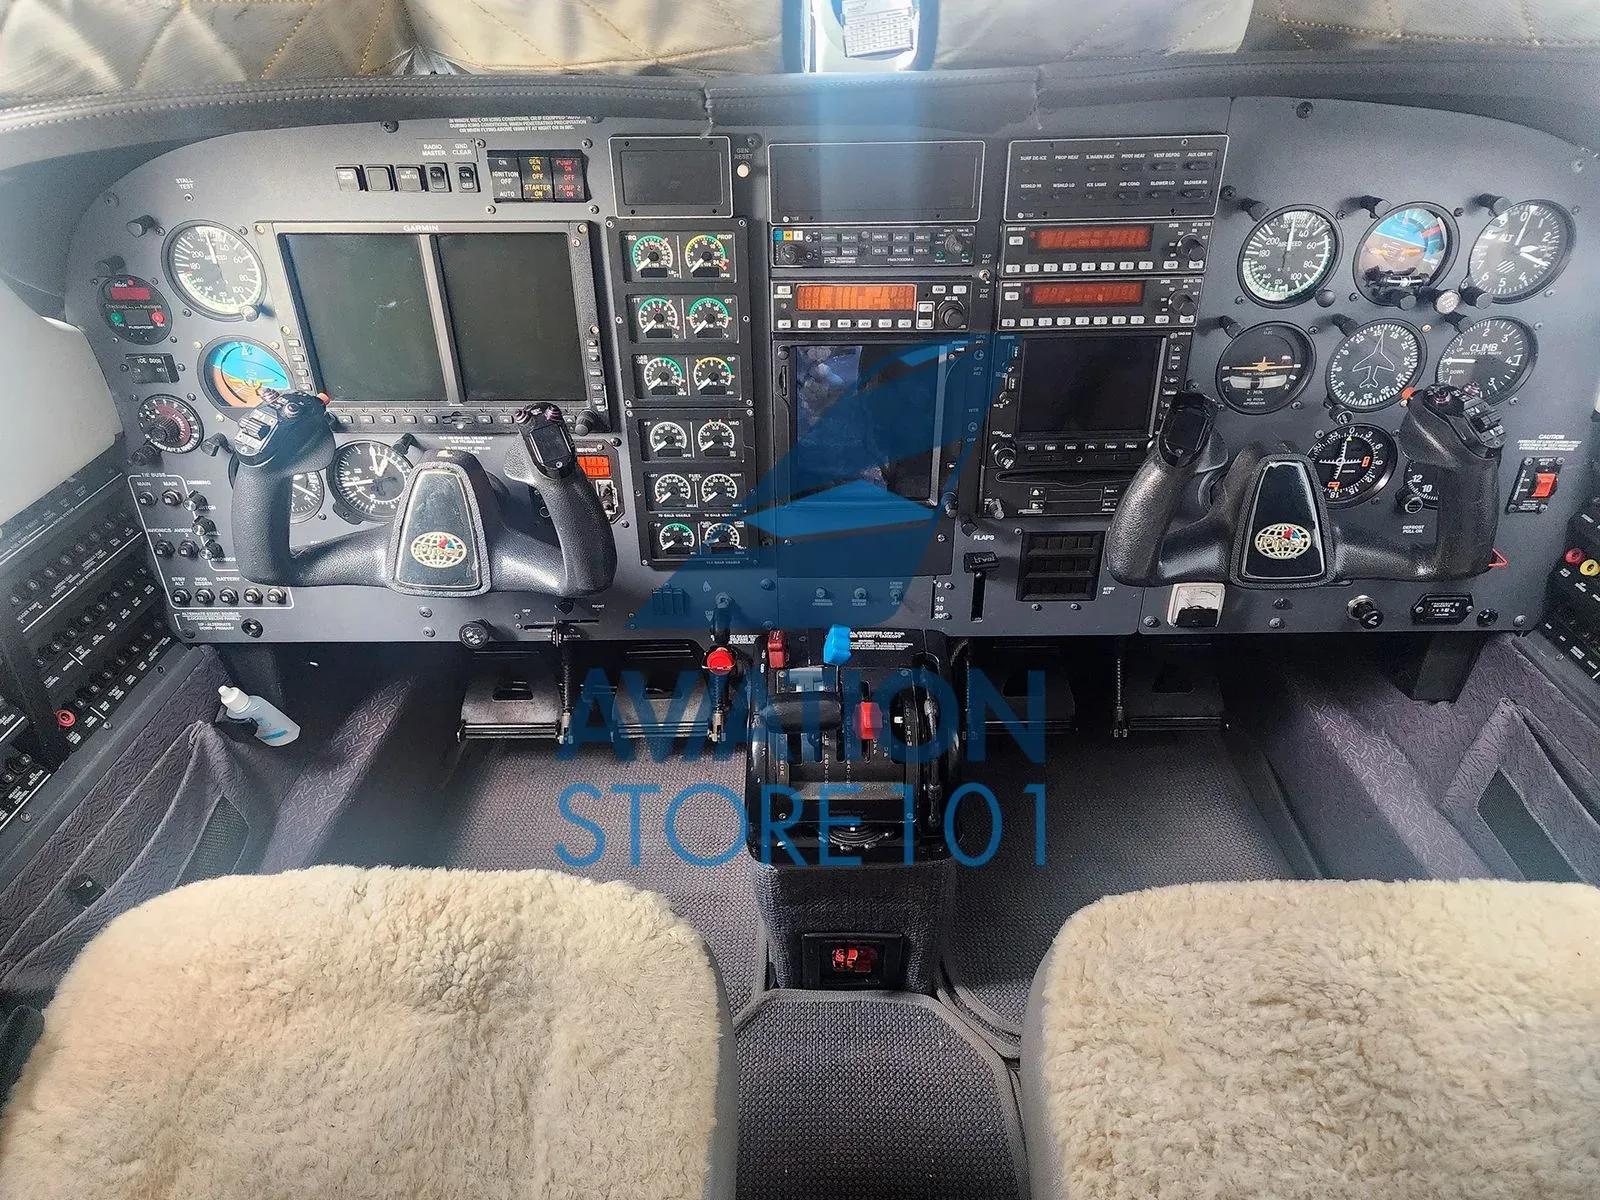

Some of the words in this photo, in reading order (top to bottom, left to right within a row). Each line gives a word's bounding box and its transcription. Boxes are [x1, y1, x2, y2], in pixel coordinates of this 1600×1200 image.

[1520, 211, 1528, 221] 0
[1498, 234, 1514, 242] ALT
[1542, 232, 1551, 242] 2
[1477, 260, 1484, 269] 7
[1482, 272, 1489, 280] 6
[1519, 272, 1526, 281] 4
[1498, 278, 1506, 287] 5
[1380, 386, 1390, 394] 30
[1366, 474, 1376, 483] 12
